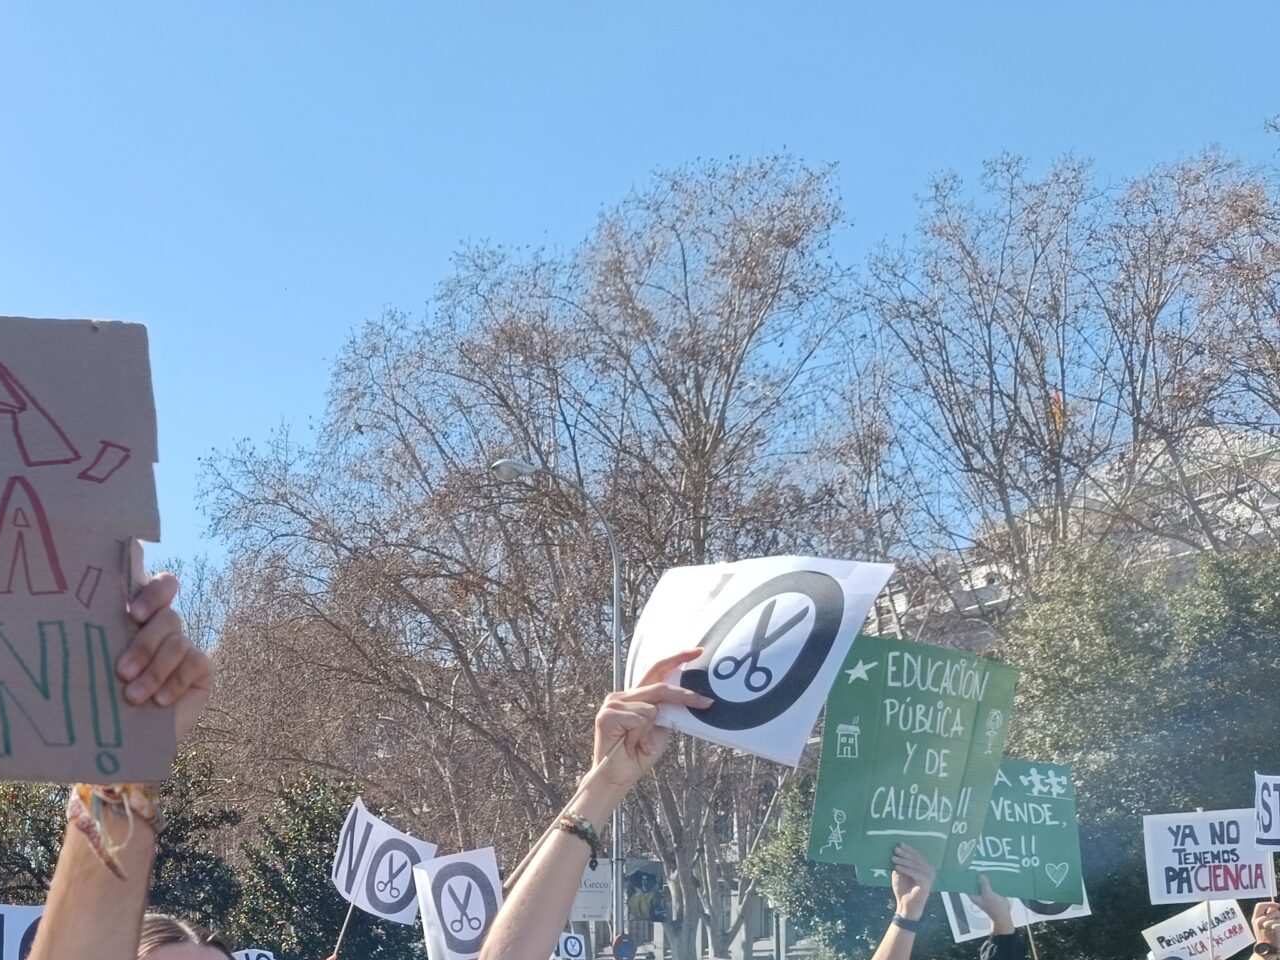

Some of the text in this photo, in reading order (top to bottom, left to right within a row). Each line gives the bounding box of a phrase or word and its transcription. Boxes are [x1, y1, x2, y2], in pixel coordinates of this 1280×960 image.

[629, 570, 845, 731] O
[886, 651, 990, 702] EDUCACIÓN
[884, 697, 965, 738] PÚBLICA
[902, 741, 950, 778] Y DE
[1167, 820, 1240, 846] YA NO
[336, 807, 420, 914] NO
[1172, 848, 1240, 866] TENEMOS
